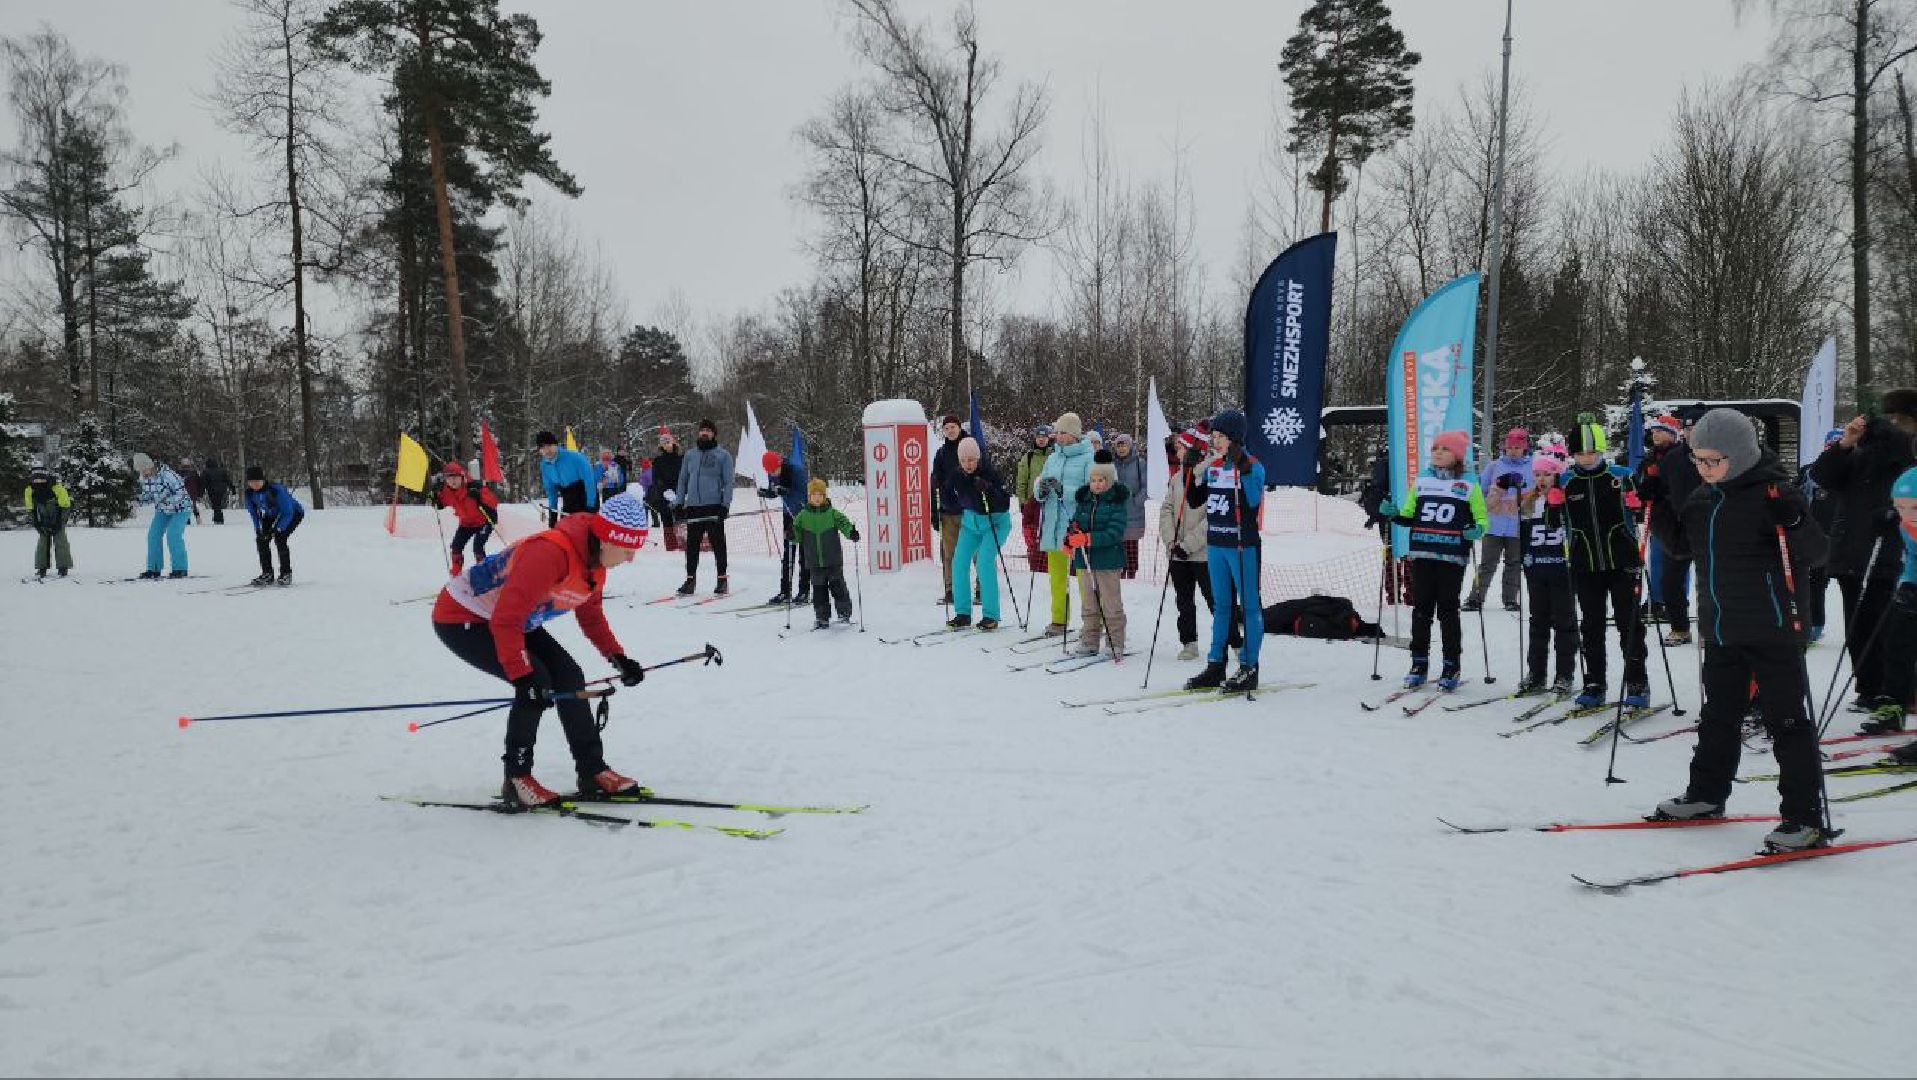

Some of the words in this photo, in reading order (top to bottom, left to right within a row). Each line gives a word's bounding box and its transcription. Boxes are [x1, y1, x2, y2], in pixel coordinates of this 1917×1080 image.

[1281, 279, 1304, 399] SNEZHSPORT
[873, 442, 892, 570] ФИНИШ
[903, 437, 926, 563] ФИНИШ
[1207, 494, 1230, 515] 54
[1421, 502, 1456, 523] 50
[1530, 524, 1564, 547] 53
